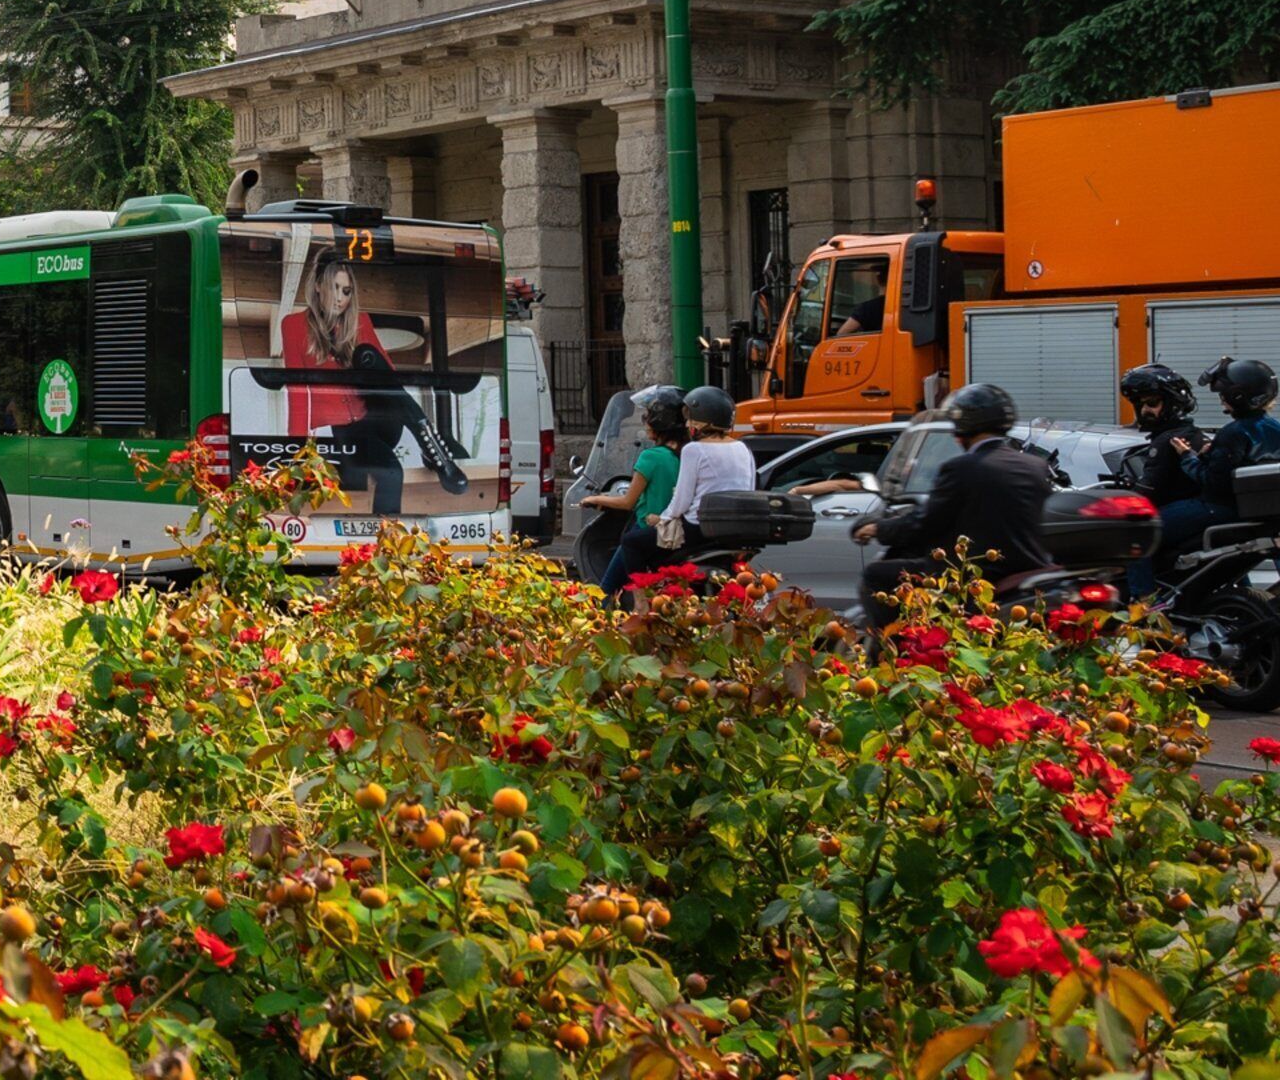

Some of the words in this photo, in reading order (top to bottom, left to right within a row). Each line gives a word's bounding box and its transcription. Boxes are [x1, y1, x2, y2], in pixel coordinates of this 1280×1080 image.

[345, 229, 372, 260] 73
[37, 256, 84, 274] ECObus
[824, 360, 861, 376] 9417
[239, 442, 357, 455] TOSCBLU
[287, 524, 300, 536] 80
[343, 521, 355, 534] EA
[450, 523, 486, 539] 2965
